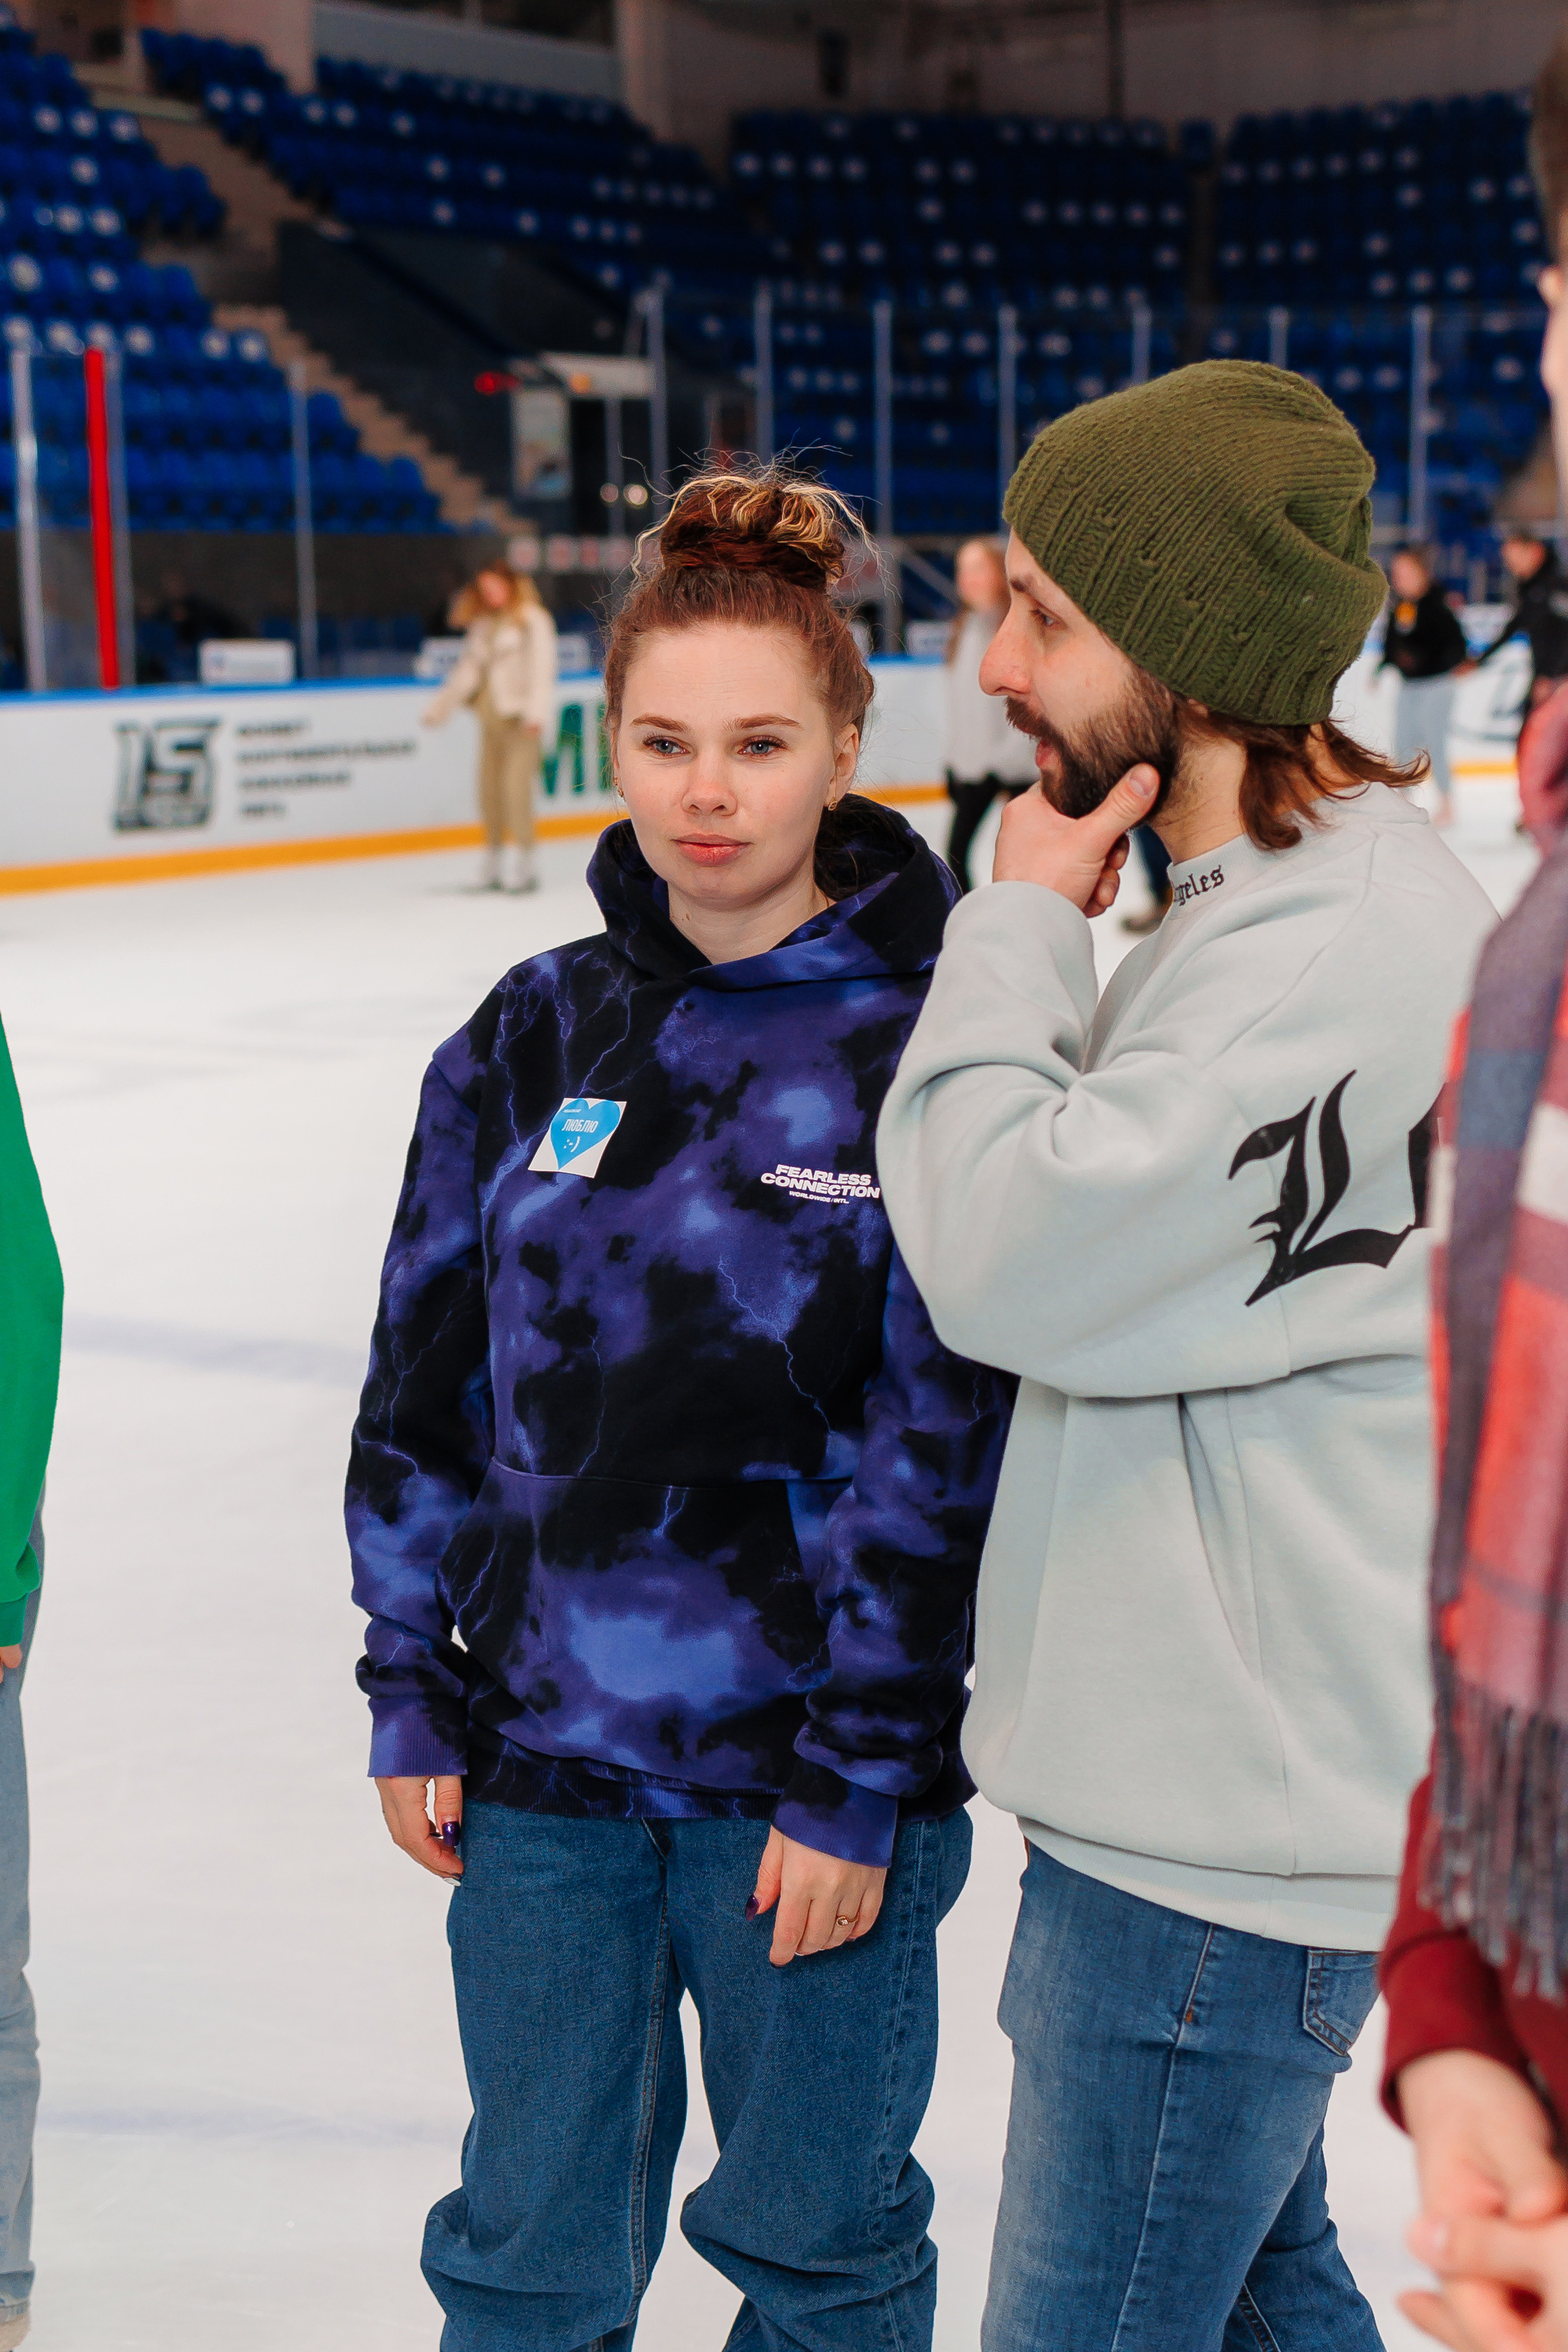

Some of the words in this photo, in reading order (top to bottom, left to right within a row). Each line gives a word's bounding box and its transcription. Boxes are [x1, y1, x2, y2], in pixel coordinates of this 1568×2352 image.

[561, 1119, 599, 1133] ЛЮБЛЮ
[761, 1173, 881, 1198] CONNECTION
[775, 1164, 872, 1186] FEARLESS
